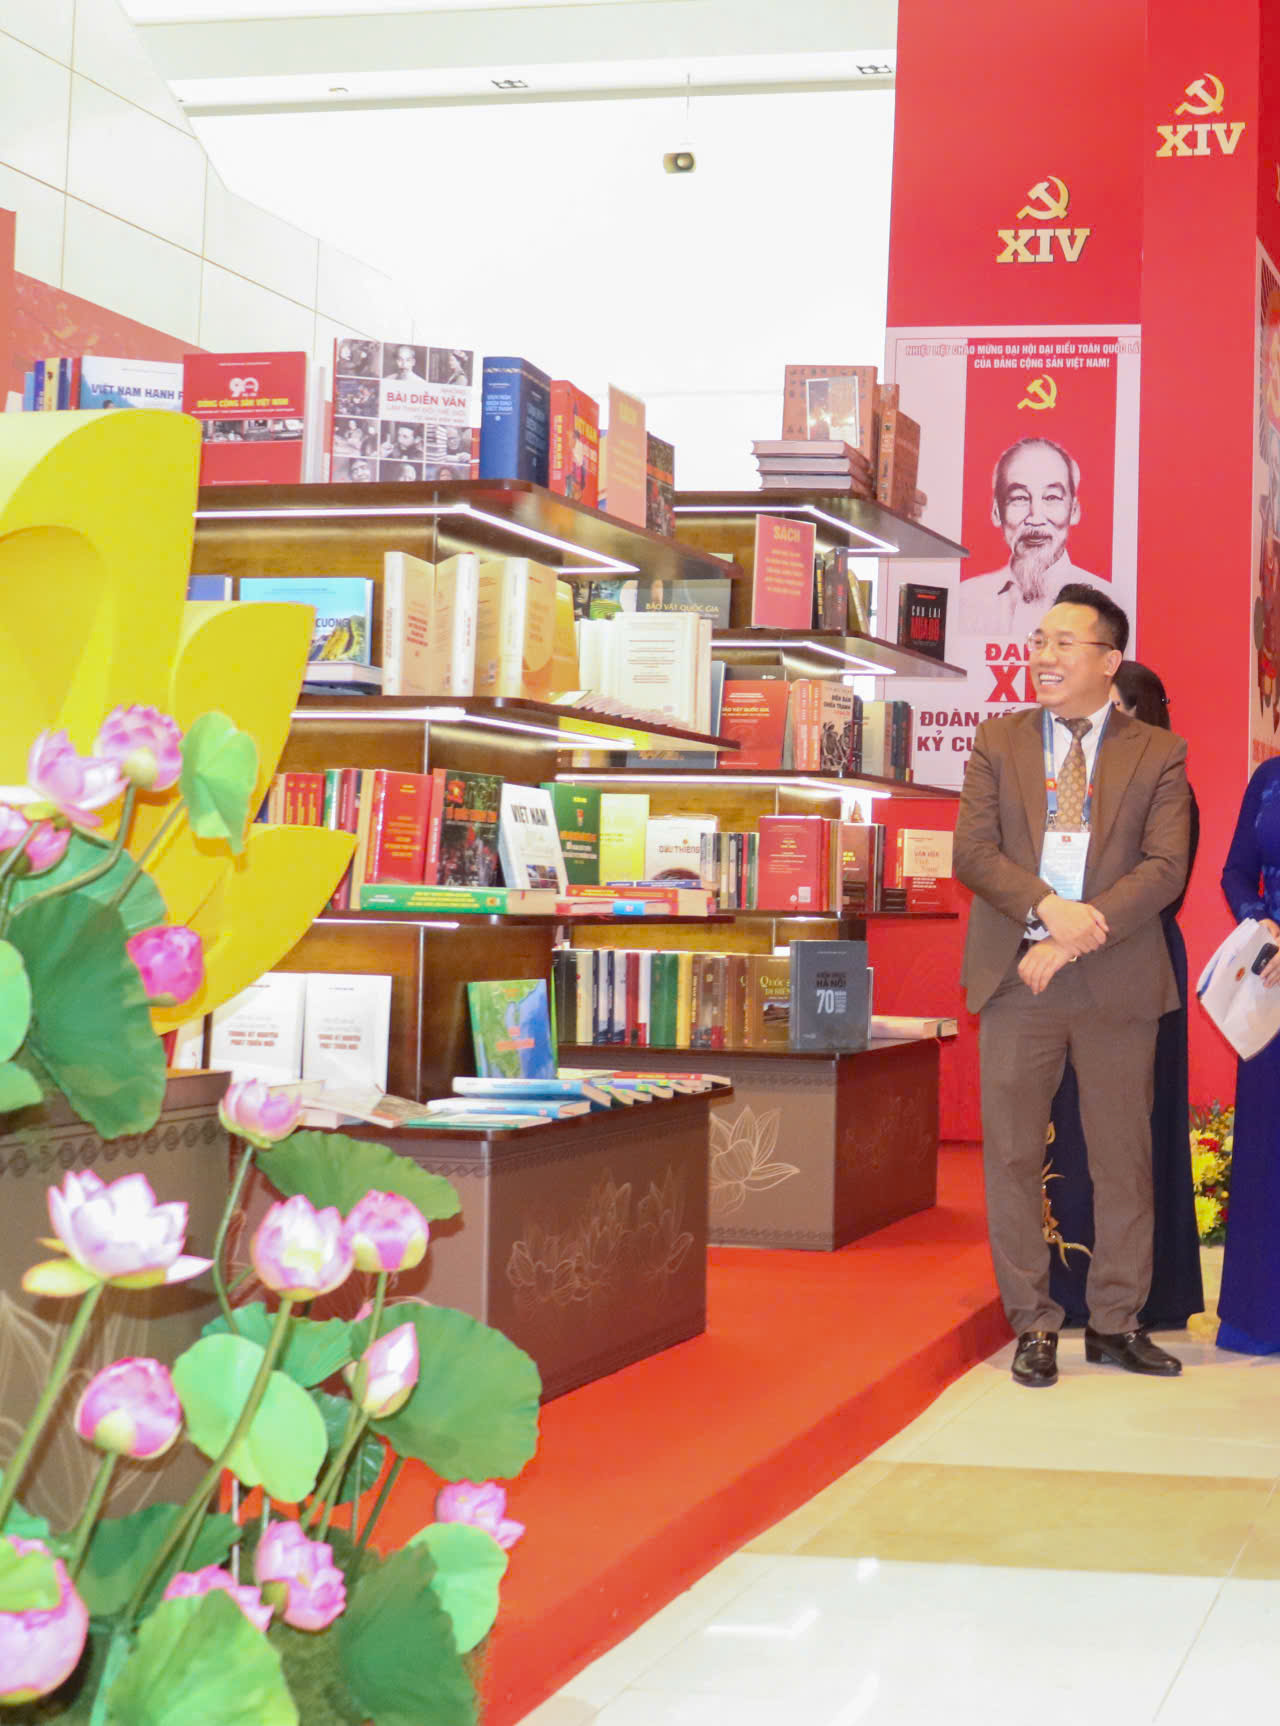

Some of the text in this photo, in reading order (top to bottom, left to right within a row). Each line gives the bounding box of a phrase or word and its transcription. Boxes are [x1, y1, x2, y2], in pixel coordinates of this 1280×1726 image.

[1156, 122, 1245, 157] XIV
[996, 228, 1091, 263] XIV
[1005, 344, 1020, 356] ĐẠI
[1039, 344, 1054, 356] ĐẠI
[974, 355, 992, 369] CỦA
[994, 355, 1018, 369] ĐẢNG
[1020, 356, 1044, 371] CỘNG
[1046, 355, 1064, 368] SẢN
[1065, 356, 1084, 370] VIỆT
[118, 385, 142, 397] NAM
[920, 708, 980, 727] ĐOÀN
[917, 729, 945, 752] KỶ
[816, 989, 835, 1014] 70
